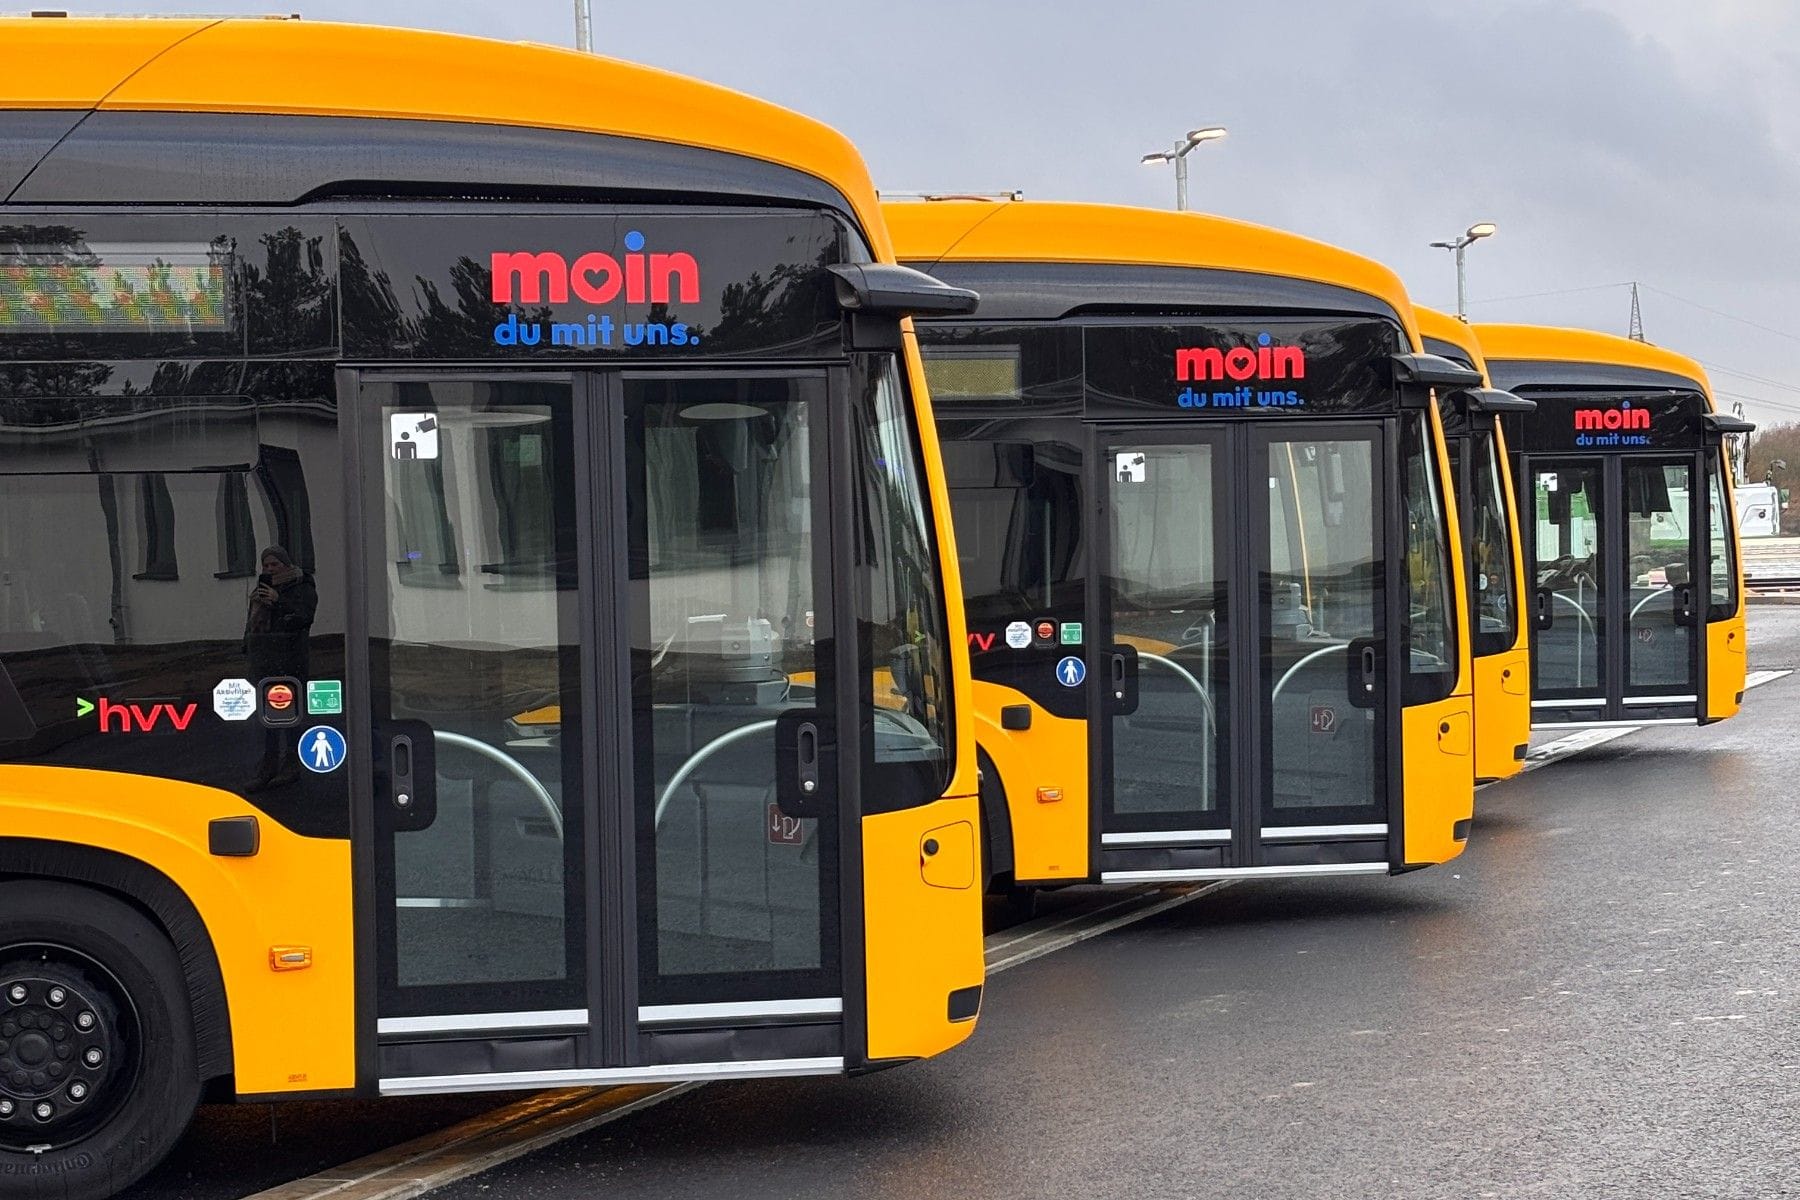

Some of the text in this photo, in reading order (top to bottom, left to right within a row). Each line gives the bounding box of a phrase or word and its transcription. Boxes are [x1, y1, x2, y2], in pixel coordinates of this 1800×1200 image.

[491, 230, 701, 304] moin
[494, 313, 700, 346] du mit uns.
[1175, 332, 1305, 381] moin
[1177, 386, 1305, 408] du mit uns.
[1574, 400, 1651, 430] moin
[1575, 433, 1594, 446] du
[1596, 432, 1620, 446] mit
